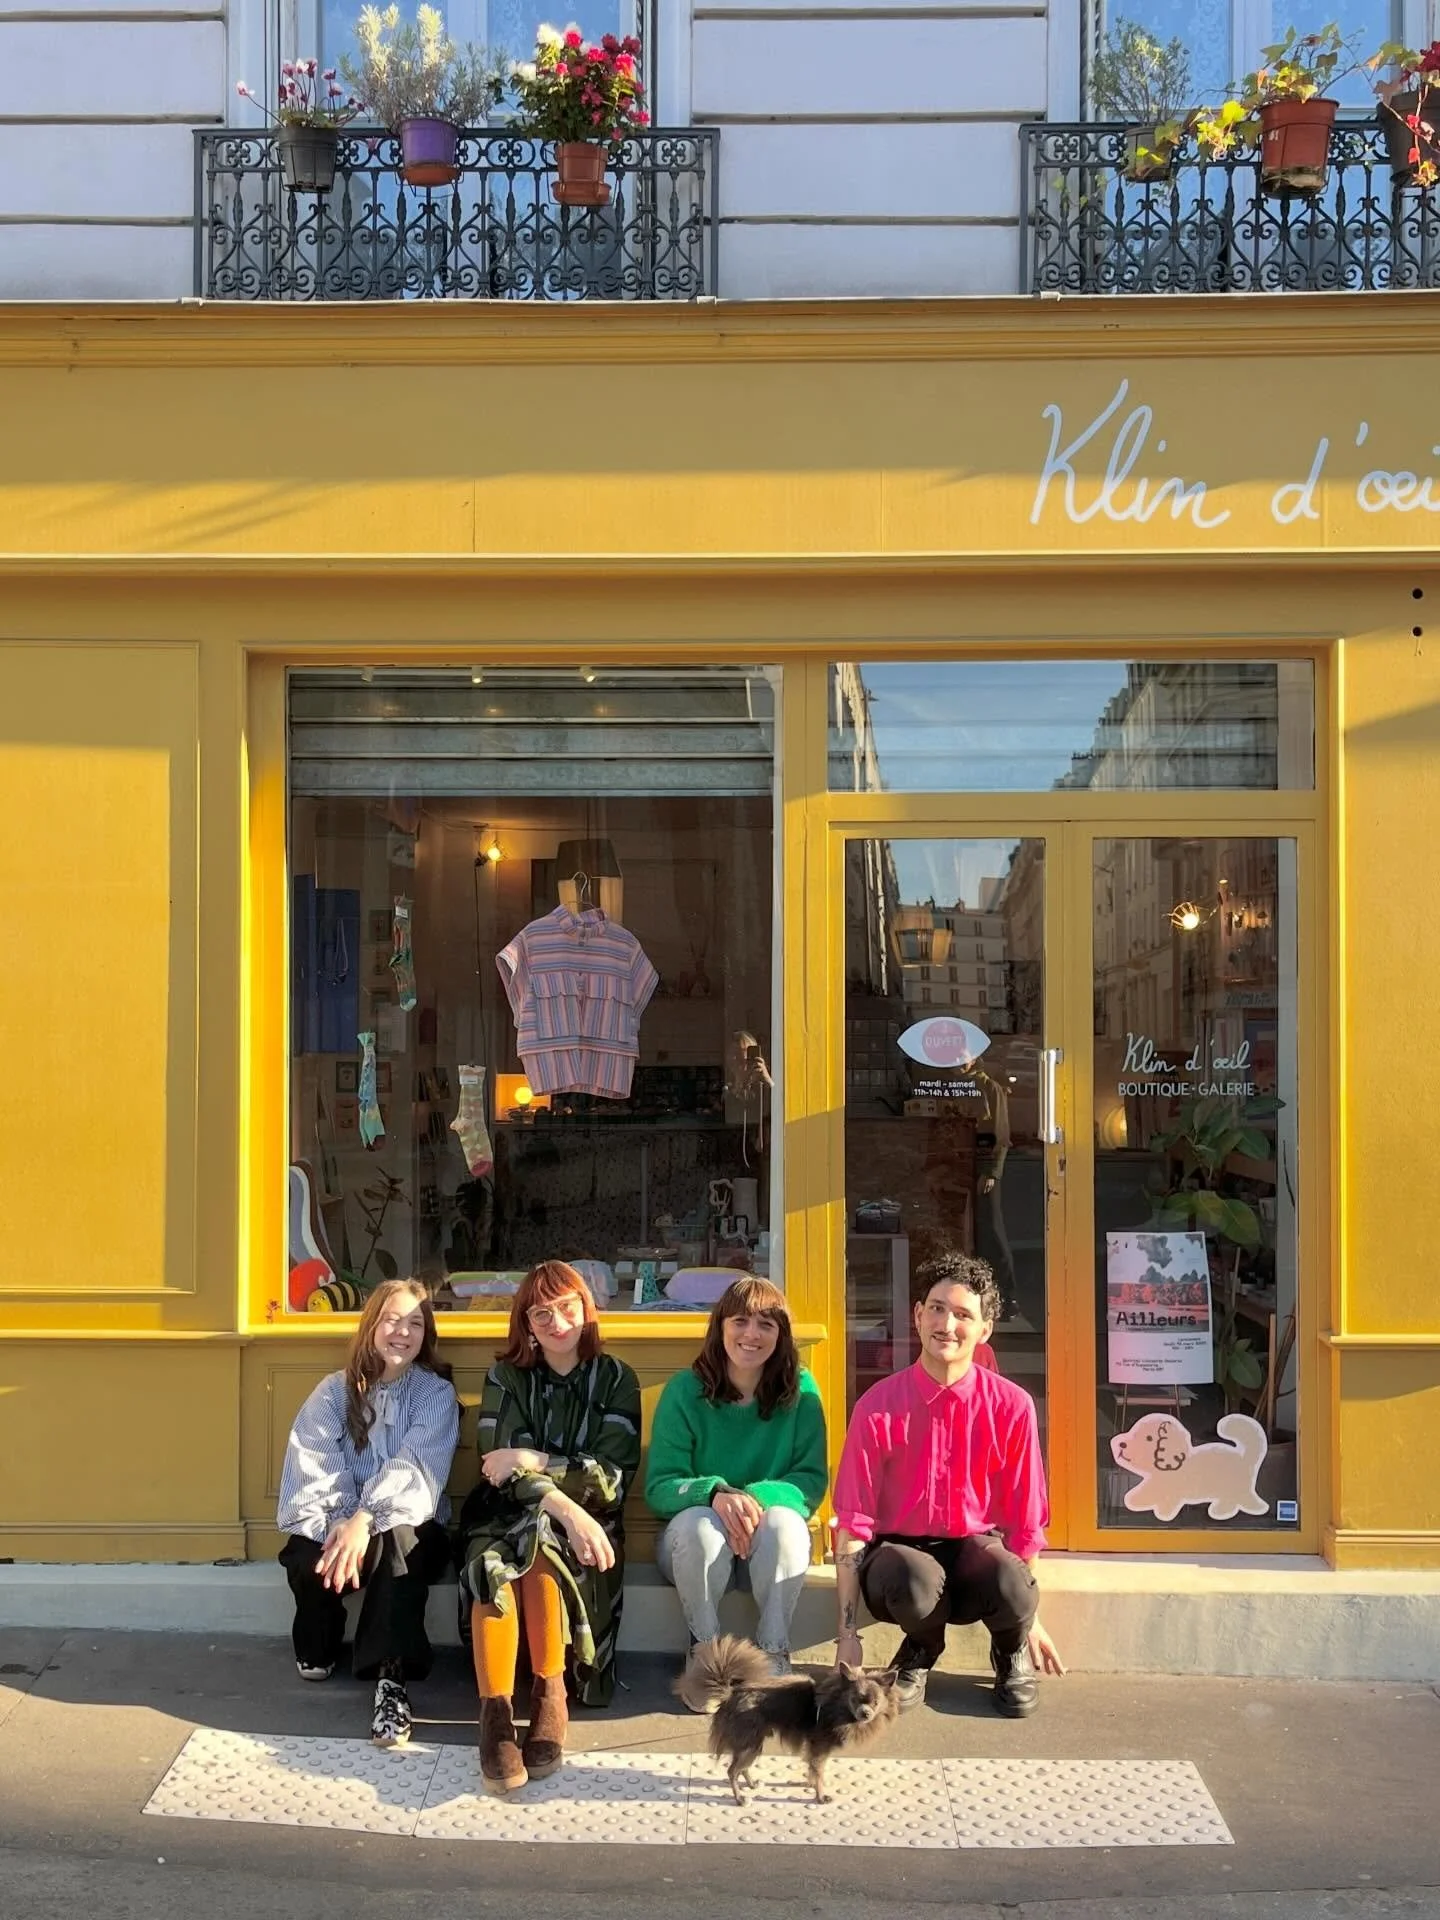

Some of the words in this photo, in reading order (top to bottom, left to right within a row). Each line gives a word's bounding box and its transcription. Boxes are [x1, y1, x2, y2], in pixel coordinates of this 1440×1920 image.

[1030, 378, 1231, 528] Klin
[1122, 1032, 1176, 1073] Klin
[920, 1080, 941, 1088] mardi
[948, 1080, 976, 1088] samedi
[914, 1088, 942, 1097] 11h-14h
[951, 1089, 982, 1097] 15h-19h
[1116, 1311, 1197, 1327] Ailleurs
